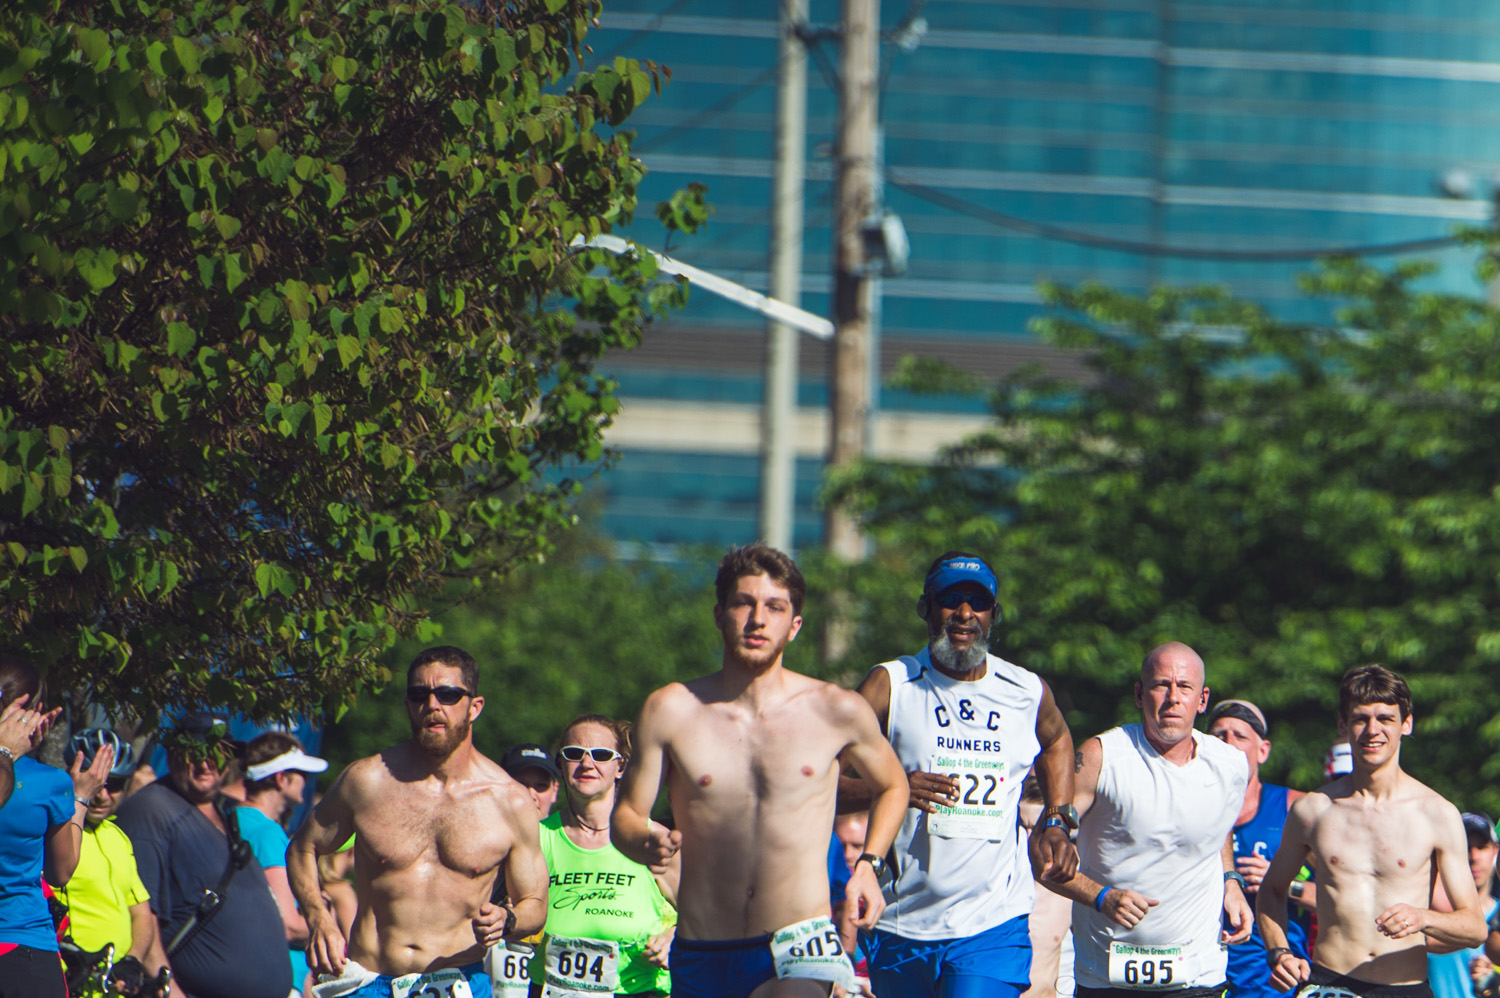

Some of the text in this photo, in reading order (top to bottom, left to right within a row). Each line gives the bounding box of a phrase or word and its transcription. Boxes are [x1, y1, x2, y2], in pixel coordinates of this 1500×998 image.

[966, 562, 981, 571] PRO
[935, 699, 1000, 731] C & C
[937, 736, 1001, 752] RUNNERS
[963, 758, 974, 768] the
[935, 805, 1002, 818] PlayRoanoke.com
[549, 872, 636, 887] FLEET FEET
[553, 886, 622, 911] Sports
[585, 908, 634, 918] ROANOKE
[789, 931, 843, 957] 605
[1116, 945, 1133, 956] Gallop
[1140, 947, 1149, 955] the
[1151, 947, 1181, 956] Greenways
[504, 955, 529, 980] 68
[558, 951, 604, 983] 694
[1125, 960, 1173, 985] 695
[549, 975, 610, 991] PlayRoanoke.com
